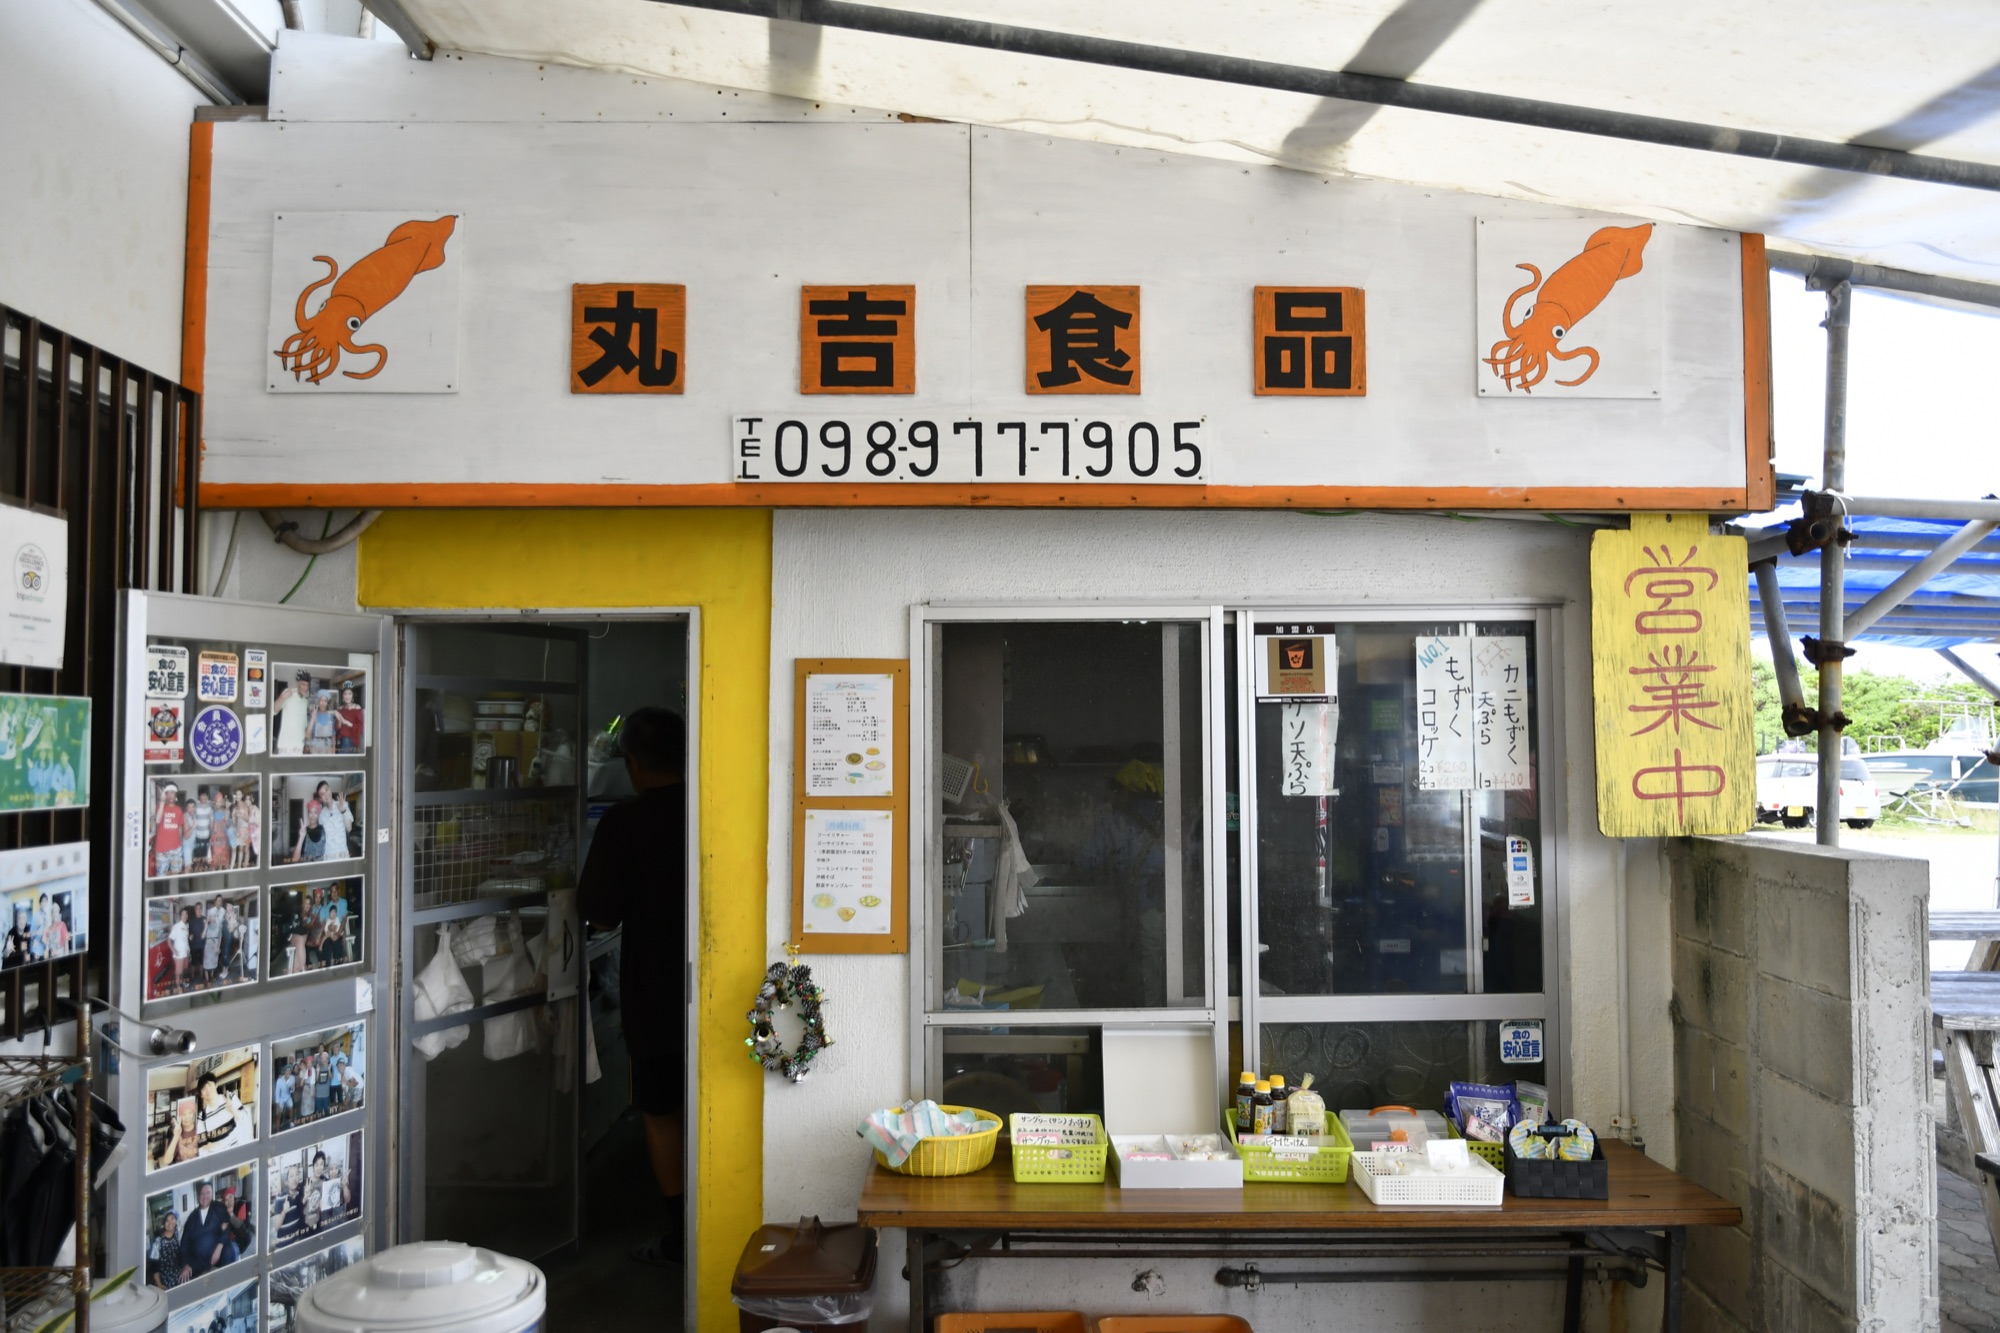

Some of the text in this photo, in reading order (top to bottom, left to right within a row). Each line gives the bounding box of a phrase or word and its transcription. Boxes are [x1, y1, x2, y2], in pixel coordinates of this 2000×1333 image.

[576, 289, 1353, 389] 丸吉食品
[740, 417, 1202, 480] TEL 098-977-7905
[1275, 625, 1315, 634] 加盟店
[1418, 636, 1450, 668] NO.1
[158, 658, 177, 671] 食の
[210, 663, 228, 676] 食の
[148, 670, 186, 693] 安心宣言
[201, 675, 236, 697] 安心宣言
[1623, 543, 1726, 829] 営業中
[1445, 656, 1471, 738] もずく
[1421, 688, 1439, 758] コロッケ
[1477, 691, 1497, 745] 天ぷら
[1503, 664, 1525, 765] カニもずく
[1493, 772, 1524, 786] ¥400
[1511, 840, 1528, 853] JCB
[1511, 1029, 1530, 1040] 食の
[1503, 1040, 1540, 1059] 安心宣言
